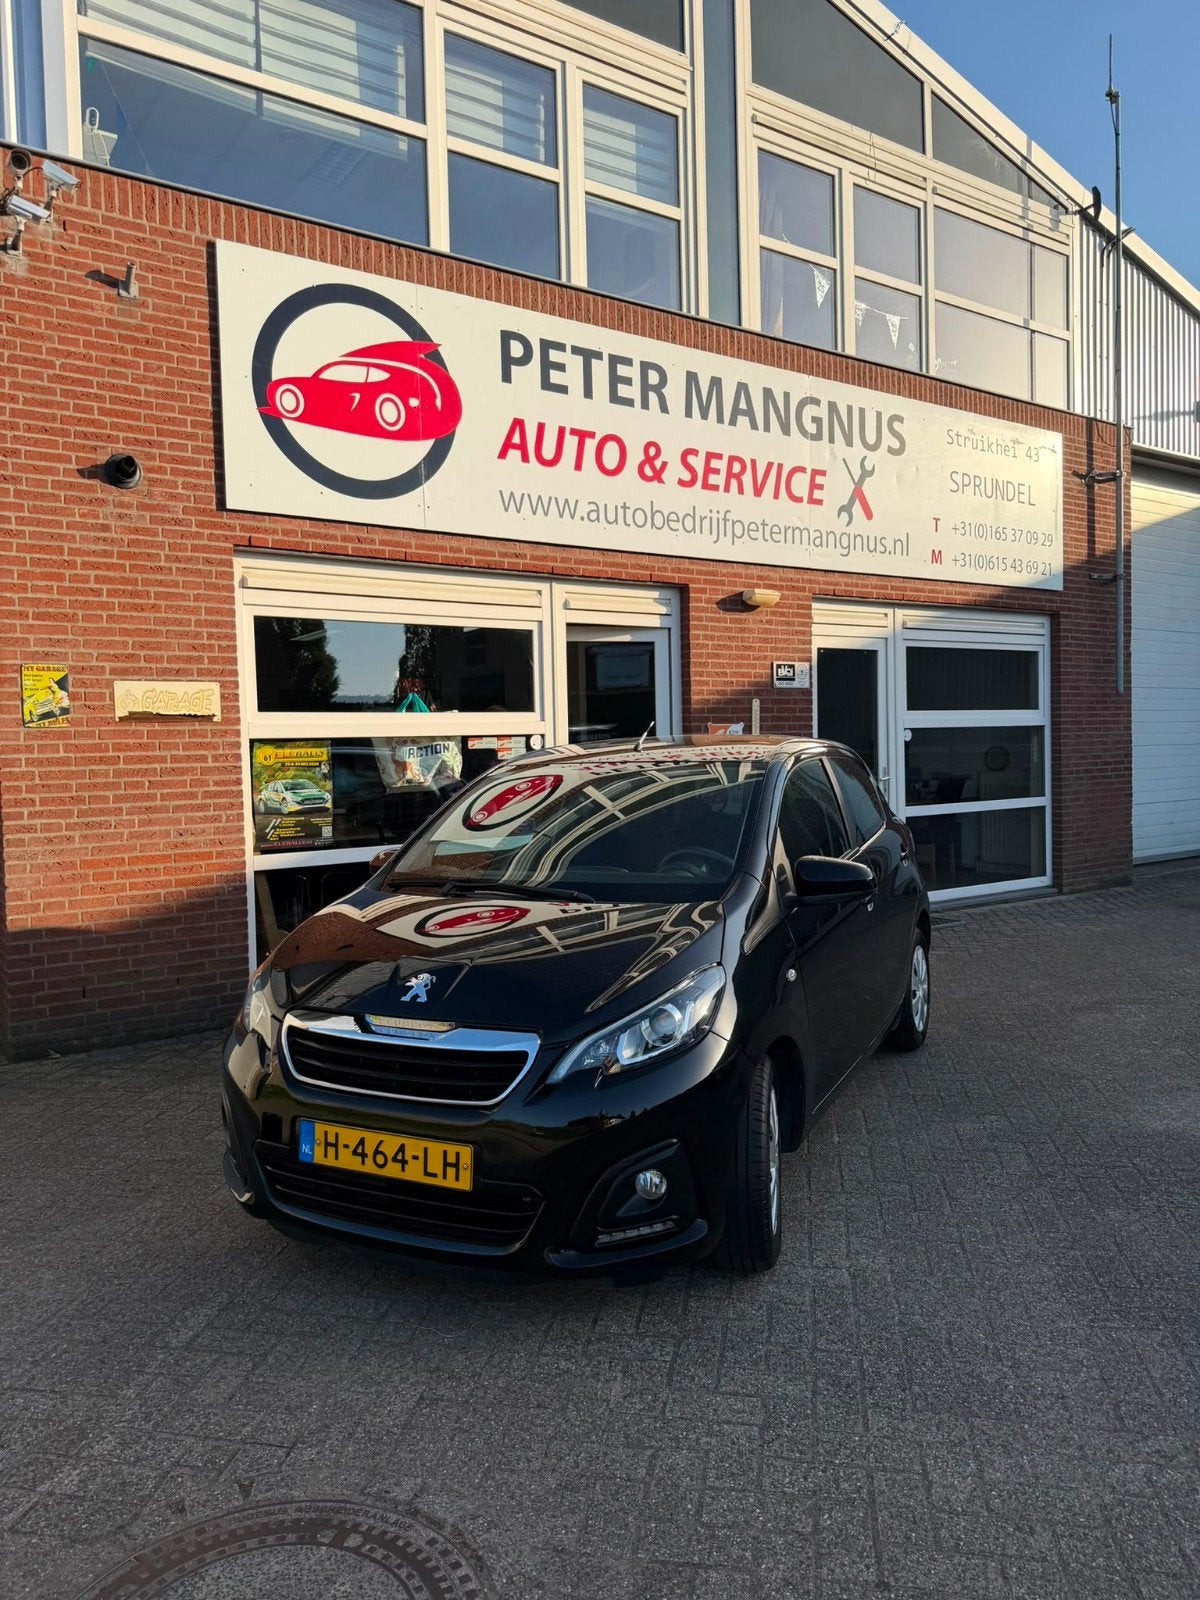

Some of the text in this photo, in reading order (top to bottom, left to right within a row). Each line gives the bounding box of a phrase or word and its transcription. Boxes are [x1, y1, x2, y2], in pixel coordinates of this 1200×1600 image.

[499, 329, 906, 457] PETER MANGNUS
[497, 417, 827, 506] AUTO & SERVICE
[946, 428, 1040, 463] Struikhei 43
[949, 470, 1036, 507] SPRUNDEL
[498, 489, 910, 557] www.autobedrijfpetermangnus.nl
[932, 517, 941, 533] T
[1010, 528, 1024, 543] 37
[1025, 530, 1039, 546] 09
[1041, 532, 1054, 548] 29
[931, 549, 943, 565] M
[1010, 558, 1023, 573] 43
[1025, 560, 1039, 575] 69
[142, 688, 215, 713] GARAGE
[263, 754, 272, 762] 61
[407, 742, 451, 759] ACTION
[301, 1143, 313, 1155] NL
[322, 1129, 461, 1183] H-464-LH
